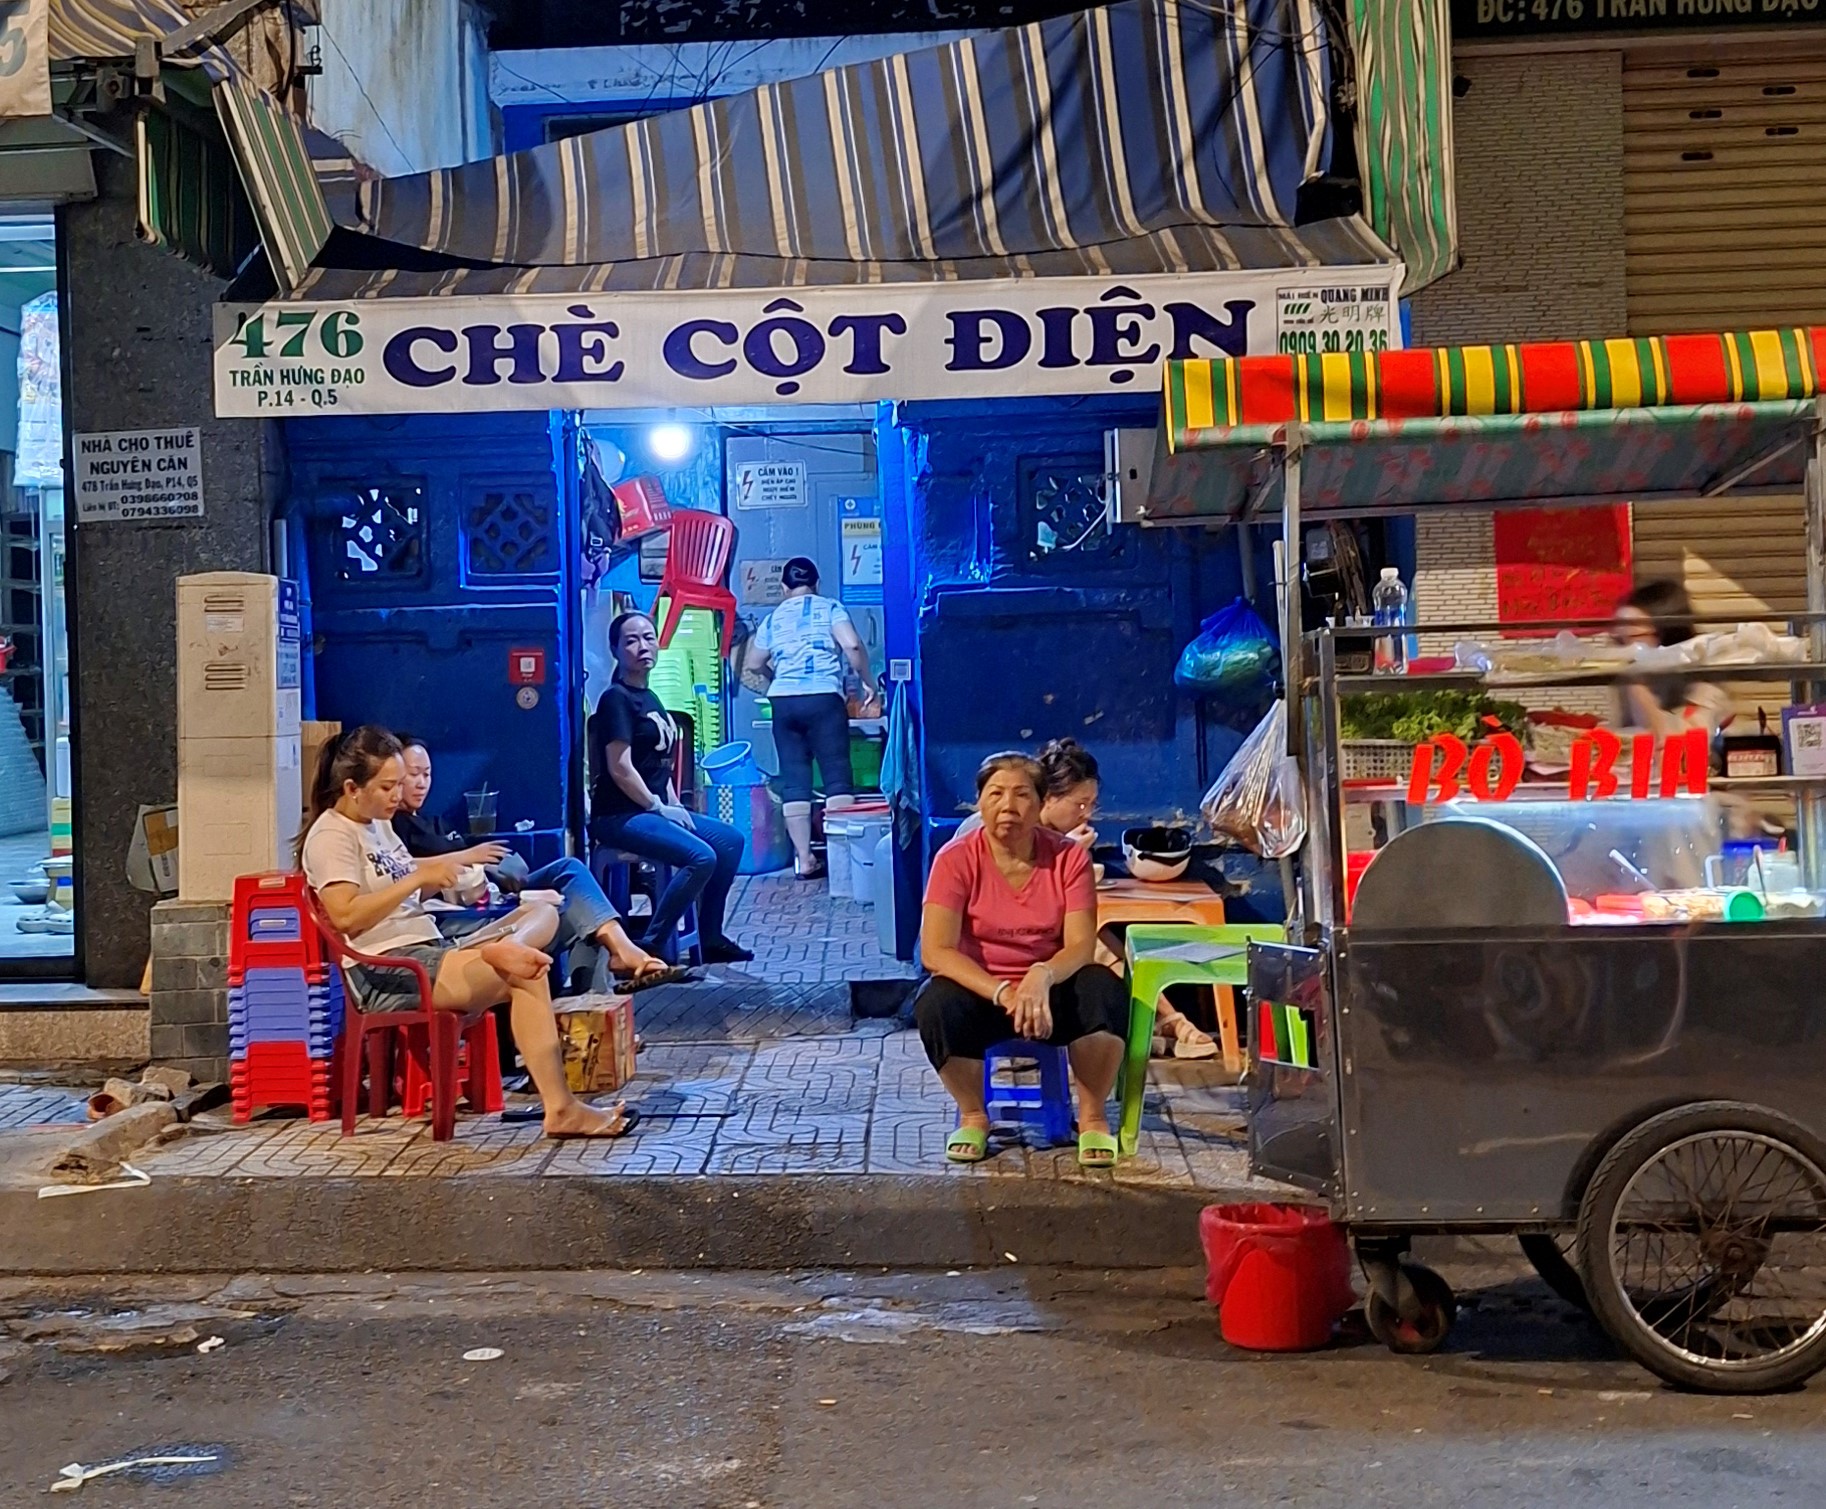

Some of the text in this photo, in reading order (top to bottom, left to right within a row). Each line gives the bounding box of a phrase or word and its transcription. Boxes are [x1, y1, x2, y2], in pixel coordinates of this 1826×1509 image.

[1320, 288, 1357, 304] QUANG
[1360, 287, 1390, 302] MINH
[228, 310, 364, 358] 476
[383, 285, 1256, 396] CHÈ CỘT ĐIỆN
[1322, 330, 1340, 352] 30
[229, 362, 365, 388] TRẦN HƯNG ĐẠO
[257, 390, 294, 407] P.14
[311, 389, 338, 408] Q.5
[81, 430, 195, 454] NHÀ CHO THUÊ
[90, 455, 188, 475] NGUYÊN CĂN
[1406, 713, 1525, 806] BÒ
